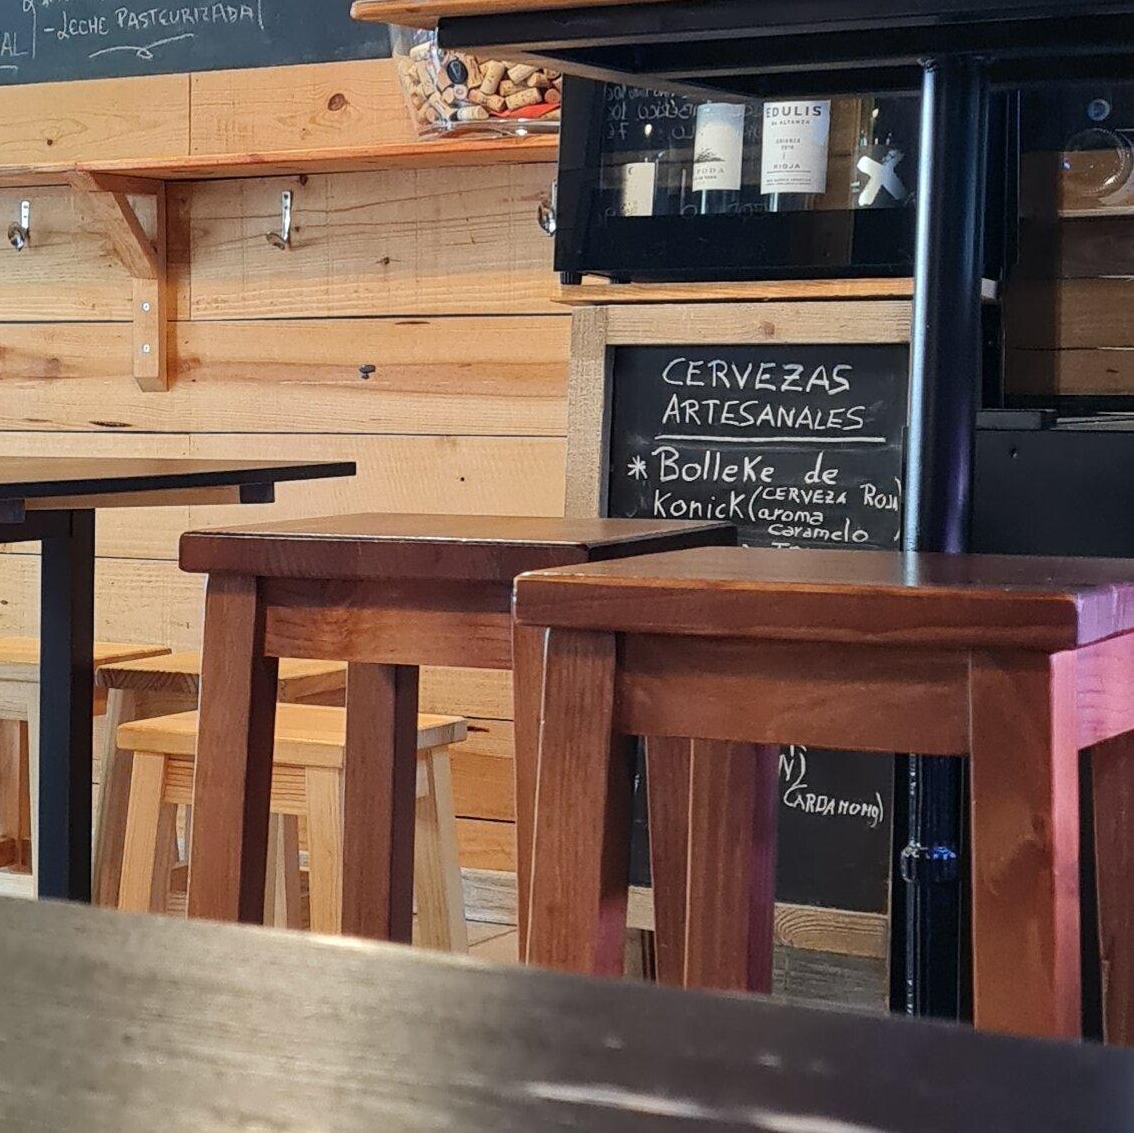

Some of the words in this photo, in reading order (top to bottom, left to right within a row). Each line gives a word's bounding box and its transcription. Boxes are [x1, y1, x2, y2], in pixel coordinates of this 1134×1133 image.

[115, 2, 254, 30] PASTEURIZADA
[766, 105, 822, 118] EDULIS
[662, 357, 853, 396] CERVEZAS
[662, 394, 866, 431] ARTESANALES
[804, 451, 839, 484] de
[757, 509, 823, 526] aroma
[767, 518, 869, 543] caramelo
